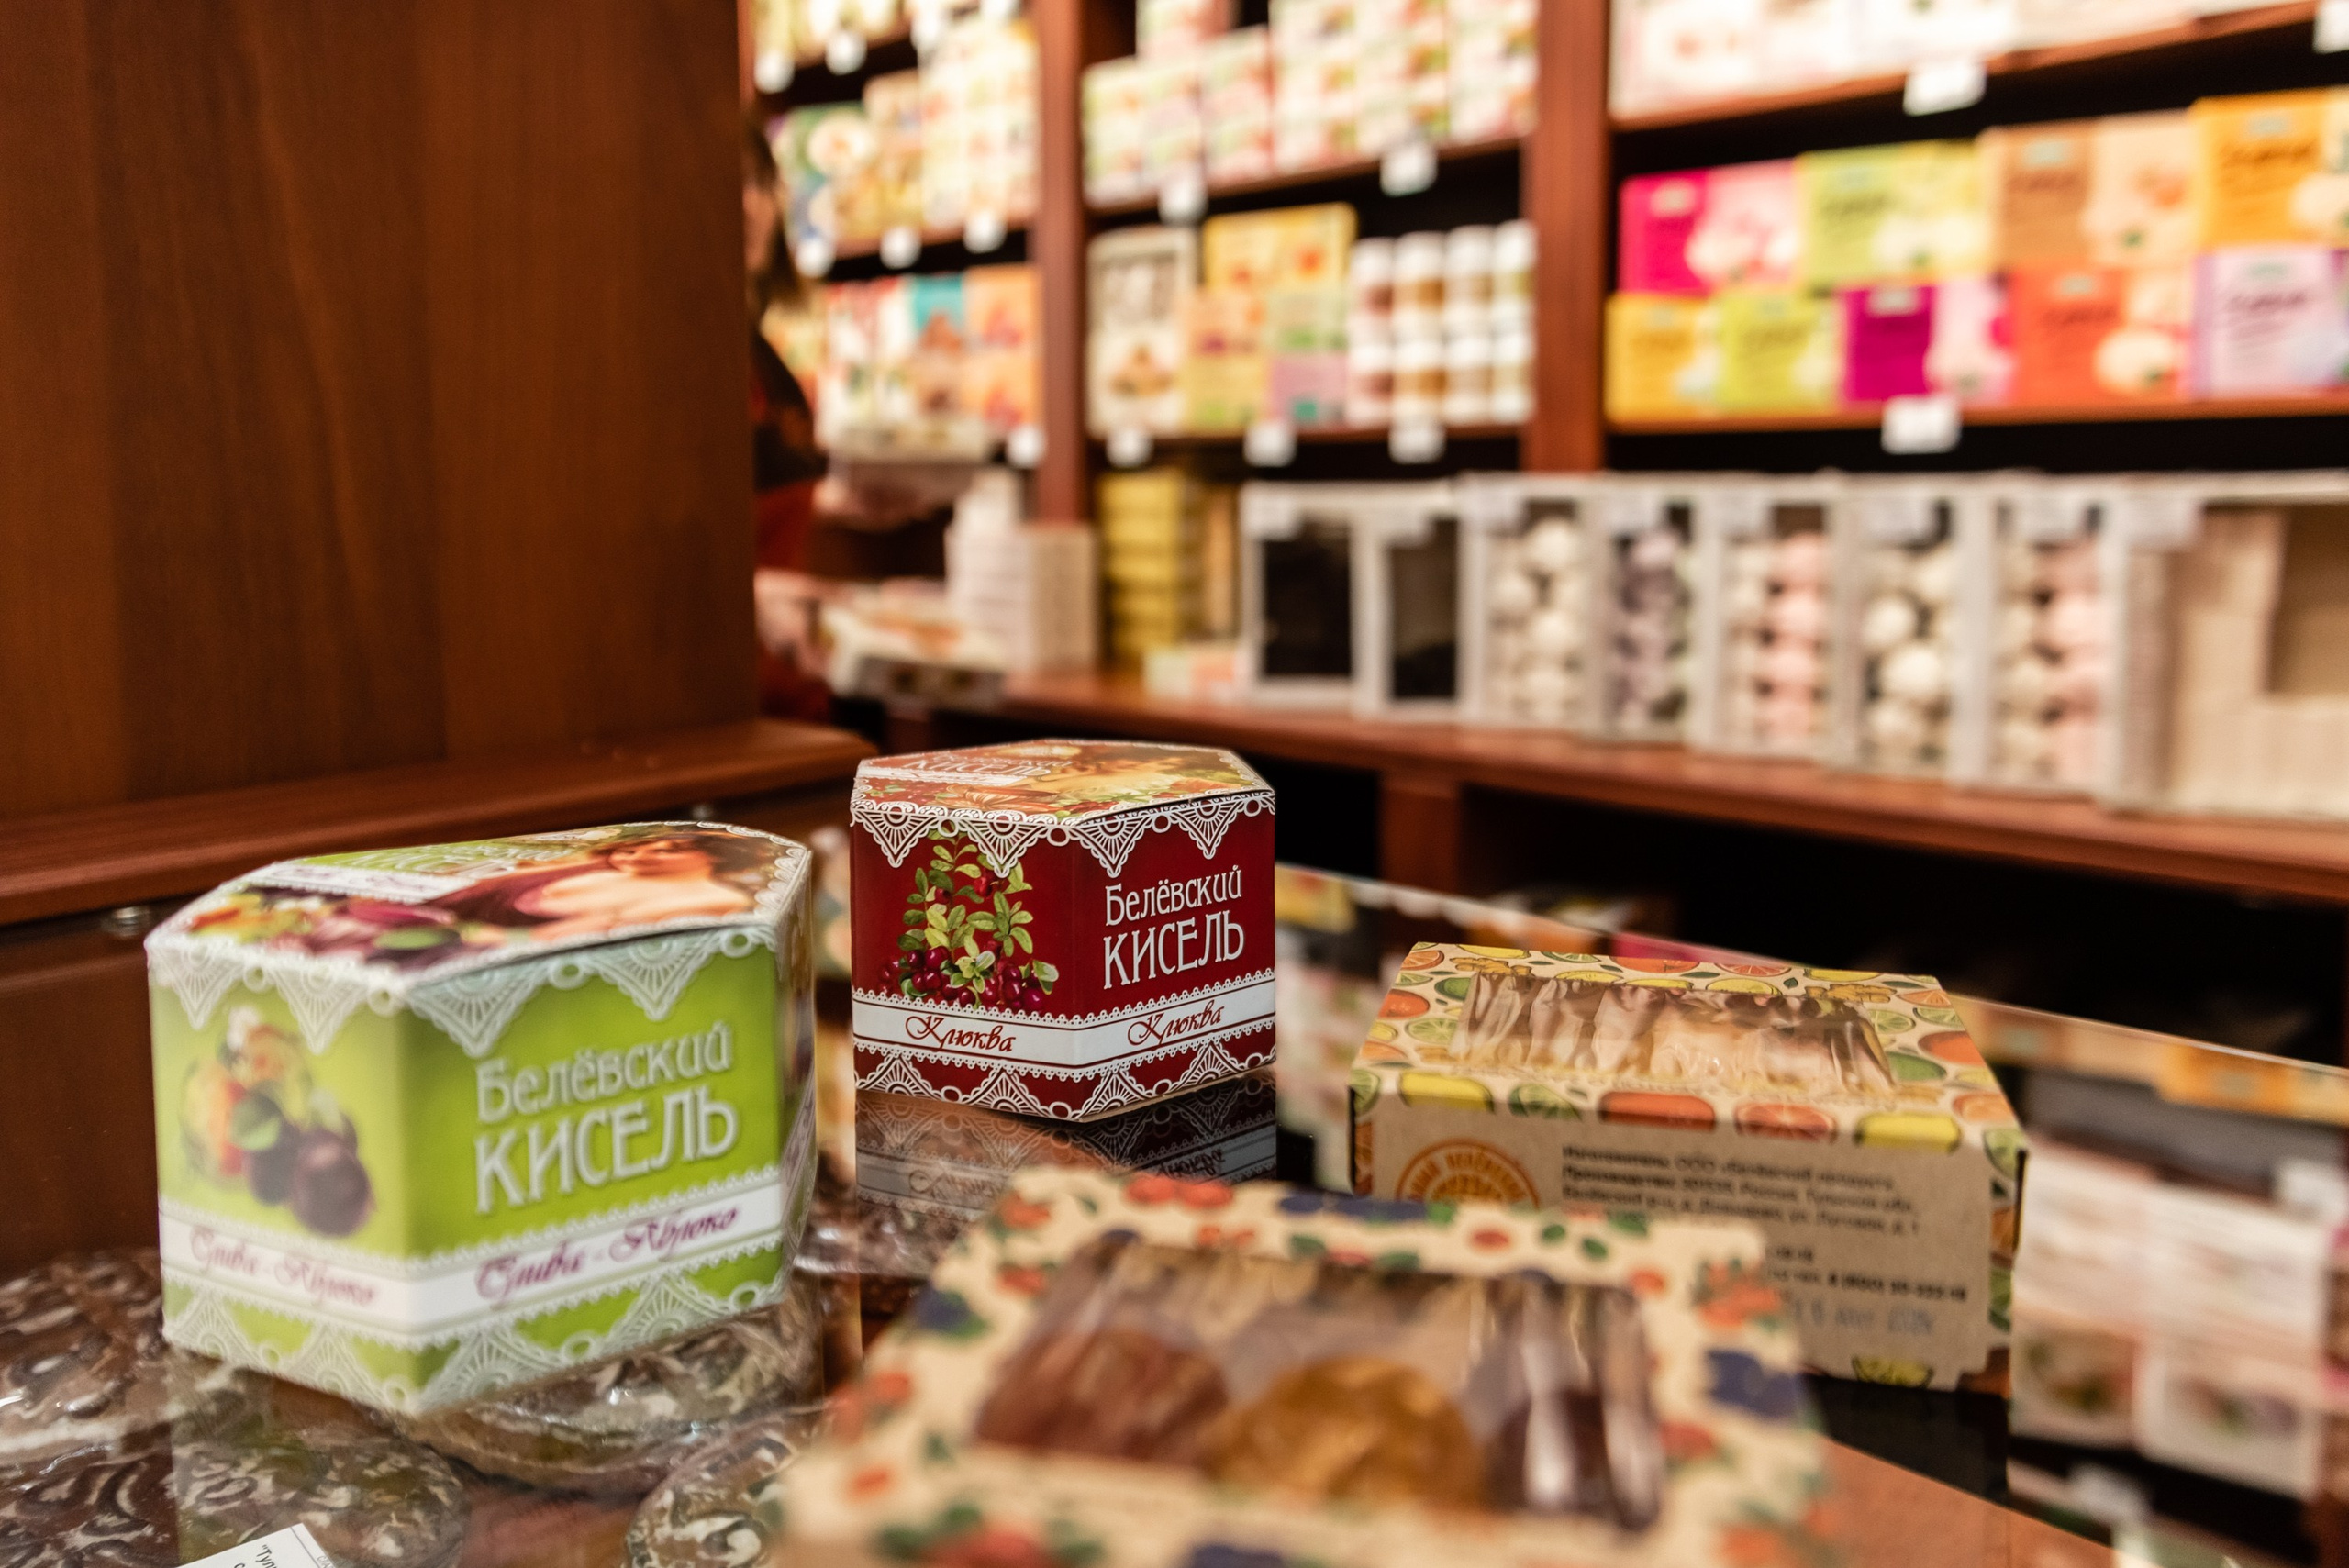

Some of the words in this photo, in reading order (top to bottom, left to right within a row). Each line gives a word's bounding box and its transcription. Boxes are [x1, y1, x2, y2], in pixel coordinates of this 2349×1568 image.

[1105, 865, 1242, 926] Белёвский
[1103, 910, 1244, 989] КИСЕЛЬ
[906, 1015, 1016, 1051] Клюква
[1128, 1000, 1225, 1046] Клюква
[476, 1020, 731, 1123] Белёвский
[475, 1084, 737, 1214] КИСЕЛЬ
[255, 1544, 277, 1568] "Тул
